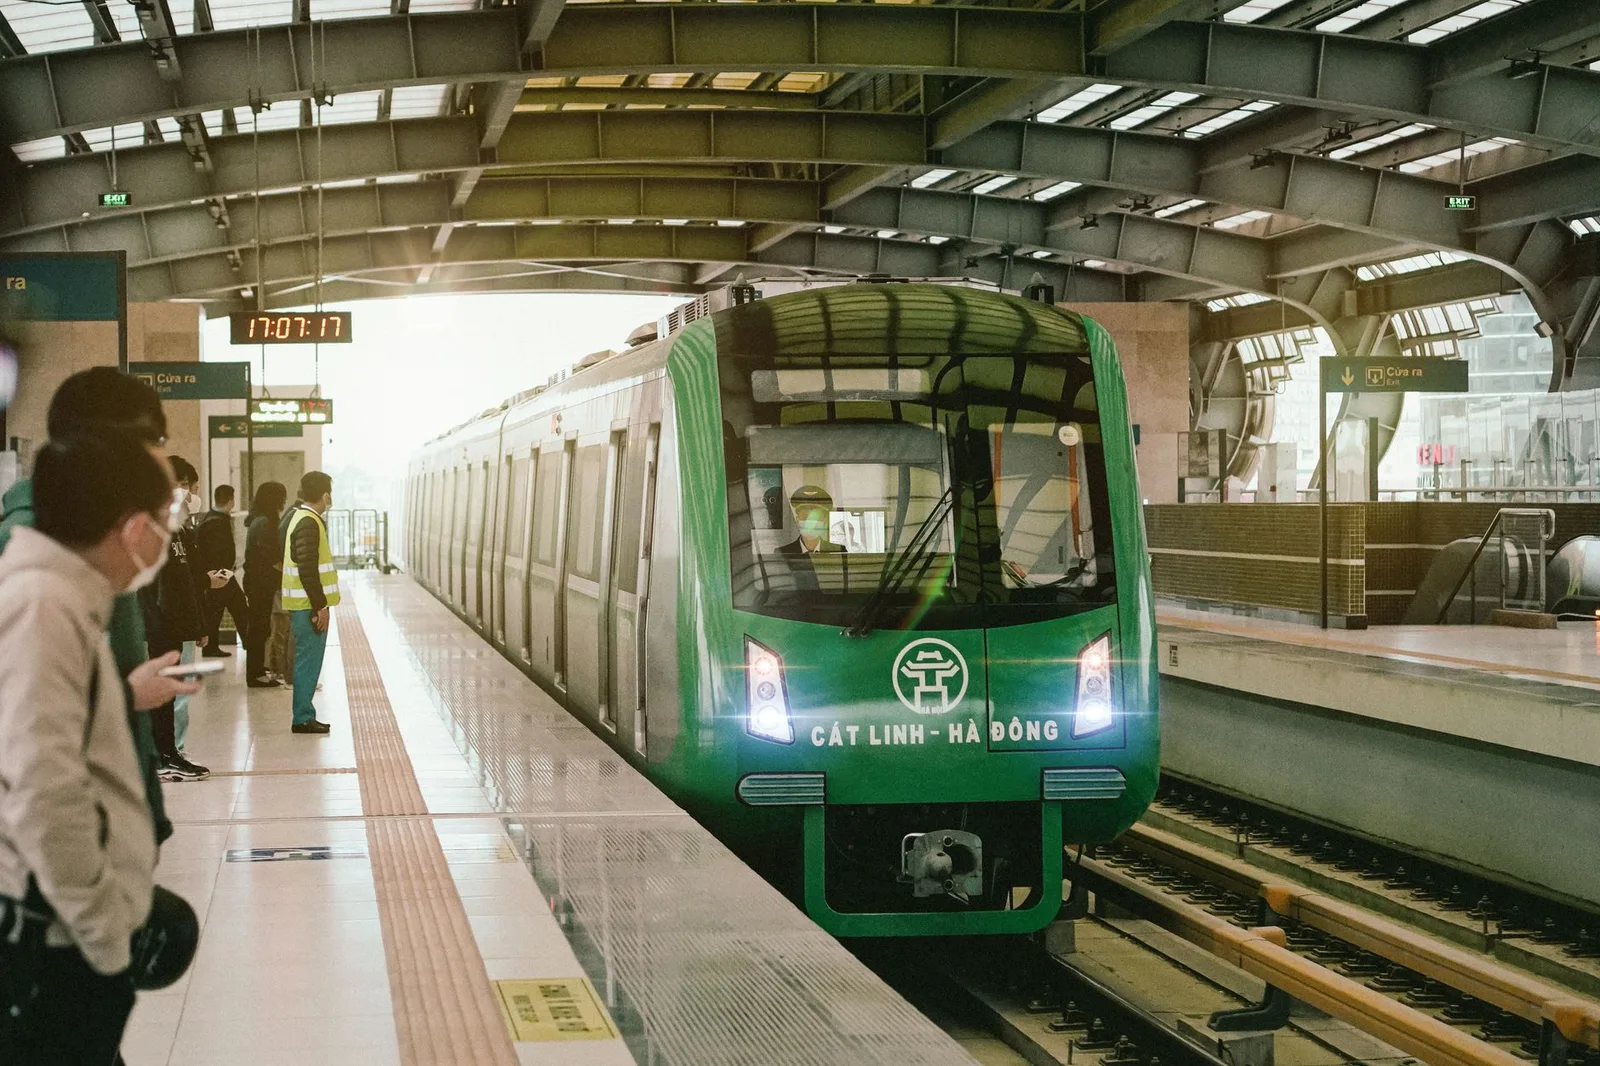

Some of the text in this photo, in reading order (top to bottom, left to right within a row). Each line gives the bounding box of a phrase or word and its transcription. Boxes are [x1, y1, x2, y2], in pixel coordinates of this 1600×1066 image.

[5, 277, 26, 291] ra
[249, 316, 341, 339] 17:07:17
[1386, 366, 1423, 377] Cửa ra
[157, 373, 196, 383] Cửa ra
[1386, 378, 1400, 386] Exit
[811, 721, 860, 747] CÁT
[869, 723, 925, 745] LINH
[949, 718, 981, 744] HÀ
[990, 715, 1059, 741] ĐÔNG
